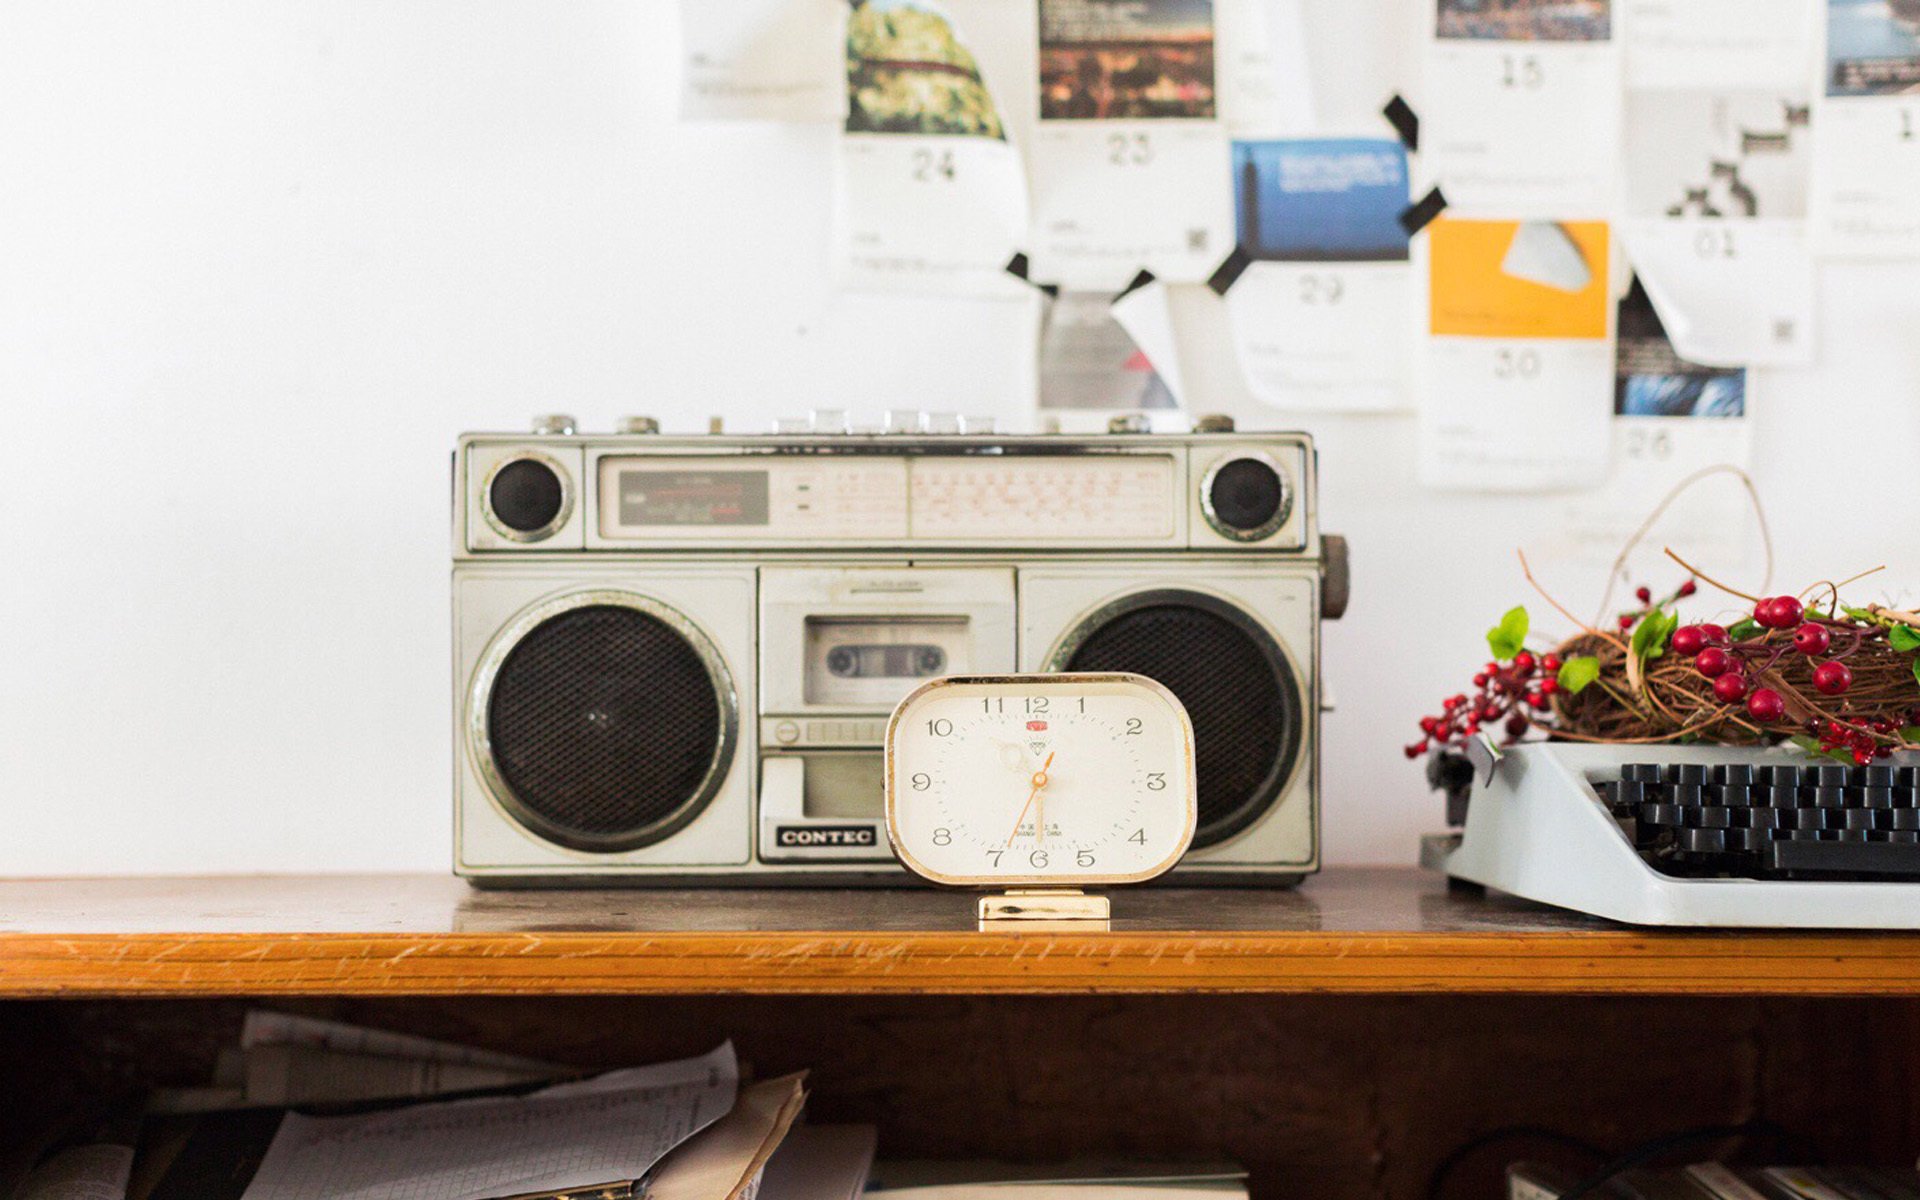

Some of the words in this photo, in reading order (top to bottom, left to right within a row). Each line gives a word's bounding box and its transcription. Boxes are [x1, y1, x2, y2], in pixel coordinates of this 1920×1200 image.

[1502, 56, 1541, 88] 15
[1107, 131, 1152, 165] 23
[911, 149, 957, 183] 24
[1695, 232, 1737, 259] 01
[1299, 274, 1344, 305] 29
[1495, 348, 1540, 378] 30
[1627, 429, 1672, 457] 26
[983, 696, 1003, 714] 11
[1024, 696, 1050, 714] 12
[1078, 696, 1085, 714] 1
[927, 718, 953, 737] 10
[1126, 717, 1143, 736] 2
[911, 772, 932, 792] 9
[1146, 772, 1167, 791] 3
[781, 830, 872, 844] CONTEC
[932, 827, 953, 847] 8
[1127, 827, 1148, 846] 4
[985, 849, 1004, 868] 7
[1029, 849, 1049, 869] 6
[1076, 849, 1096, 868] 5
